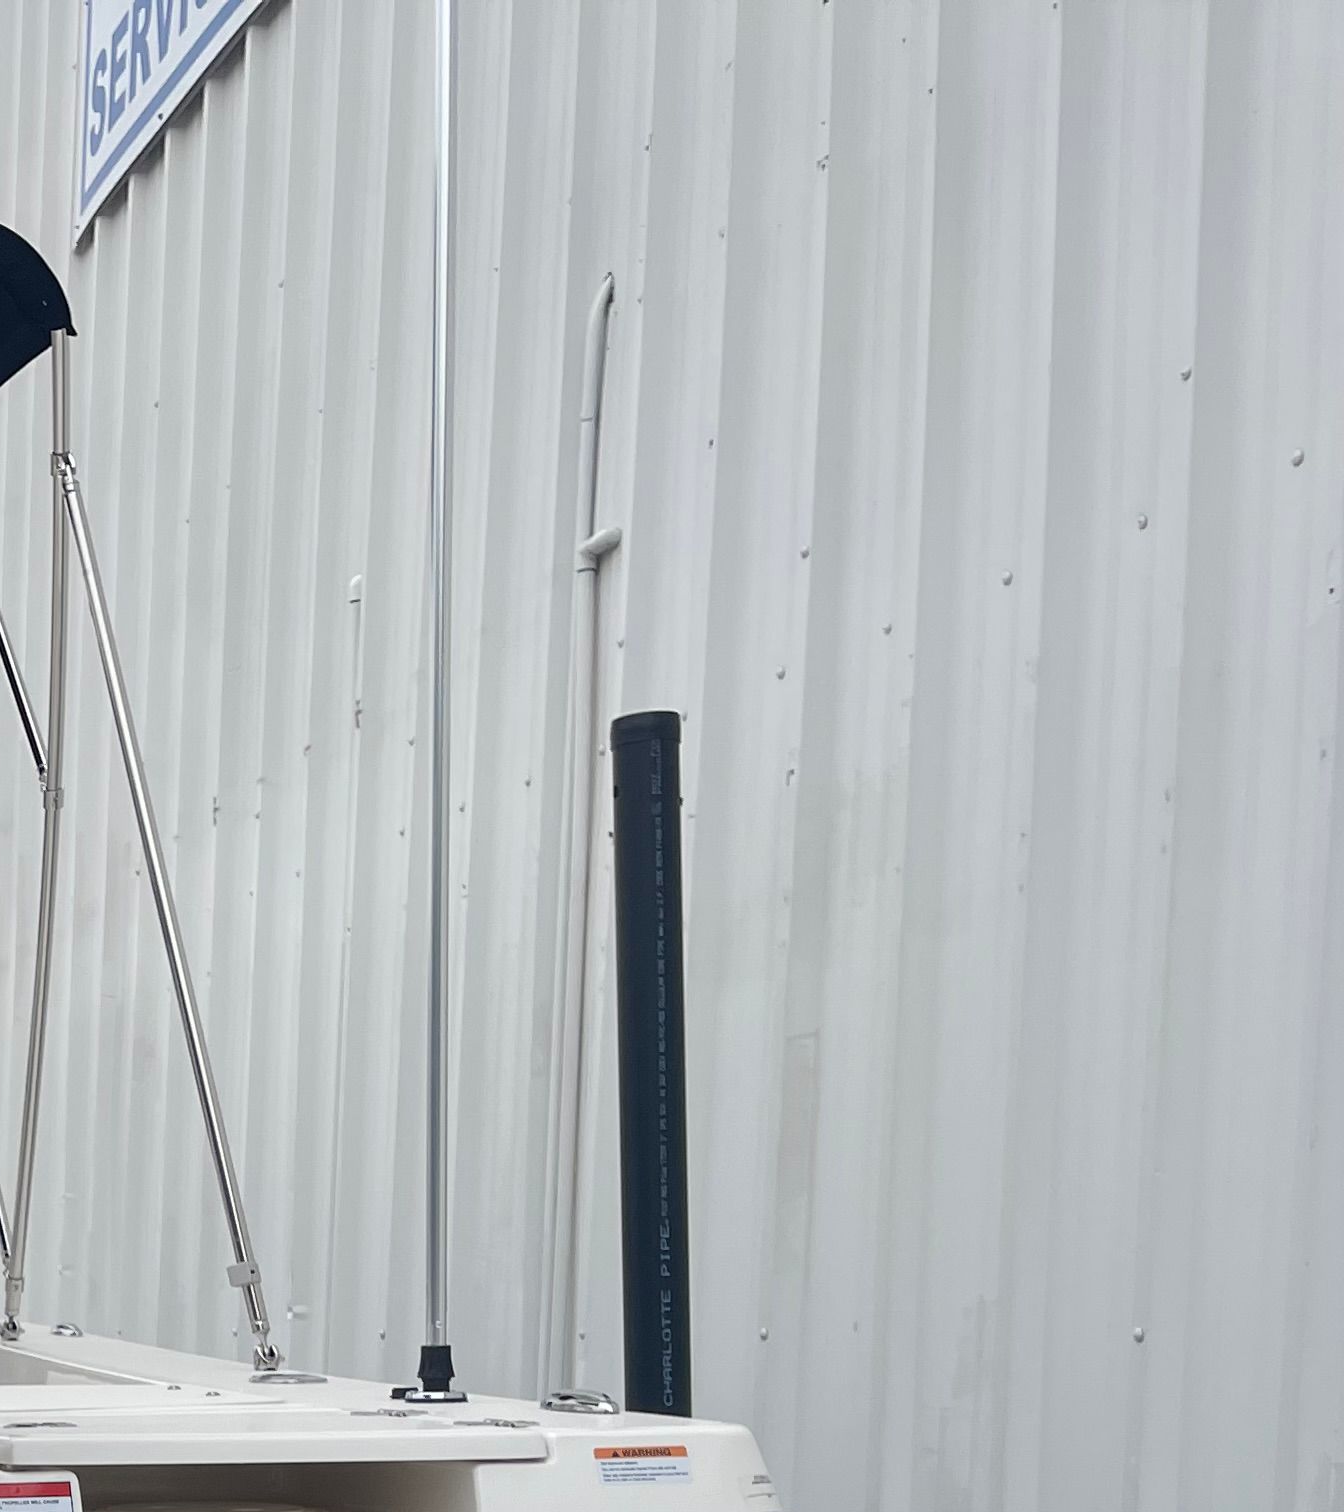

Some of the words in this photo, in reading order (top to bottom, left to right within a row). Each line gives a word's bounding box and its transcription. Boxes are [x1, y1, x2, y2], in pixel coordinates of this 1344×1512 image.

[90, 0, 207, 157] SERV
[660, 1289, 674, 1407] CHARLOTTE
[621, 1447, 672, 1458] WARNING
